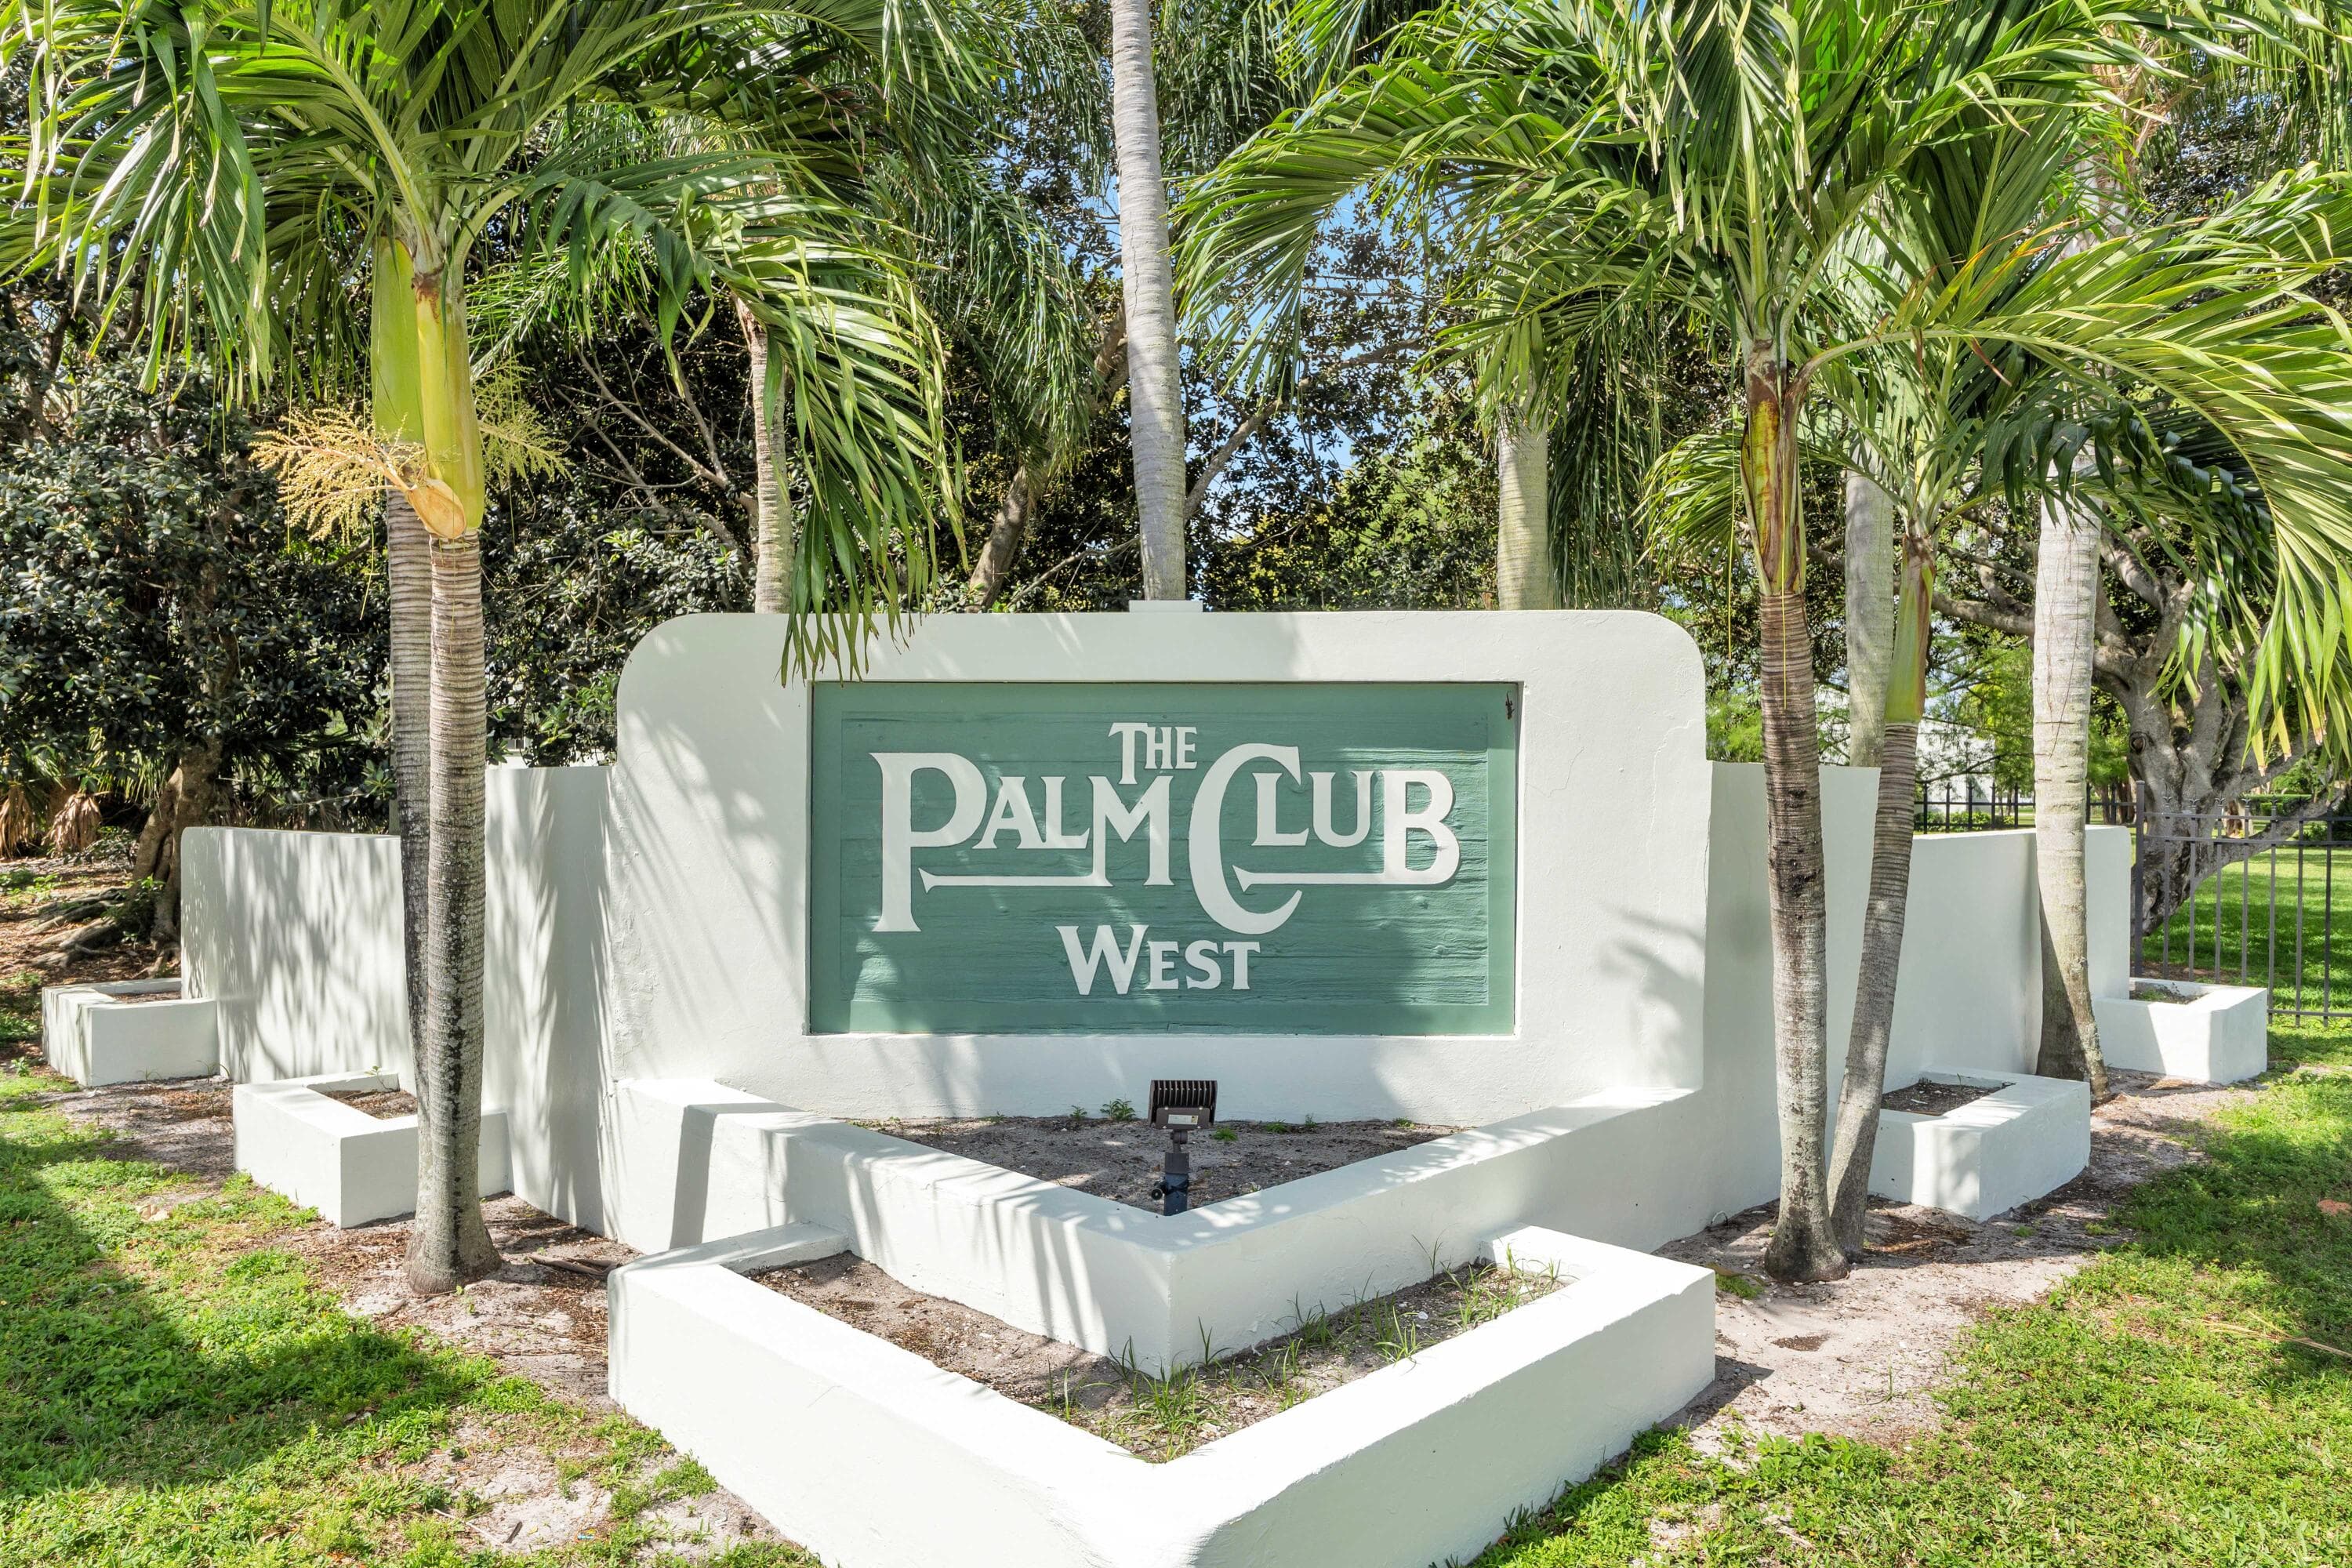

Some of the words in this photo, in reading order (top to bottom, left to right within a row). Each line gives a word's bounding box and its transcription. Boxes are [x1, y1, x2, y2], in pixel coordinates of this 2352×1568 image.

[1108, 722, 1198, 785] THE
[869, 752, 1174, 933] PALM
[1189, 743, 1461, 935] CLUB
[1054, 924, 1261, 996] WEST
